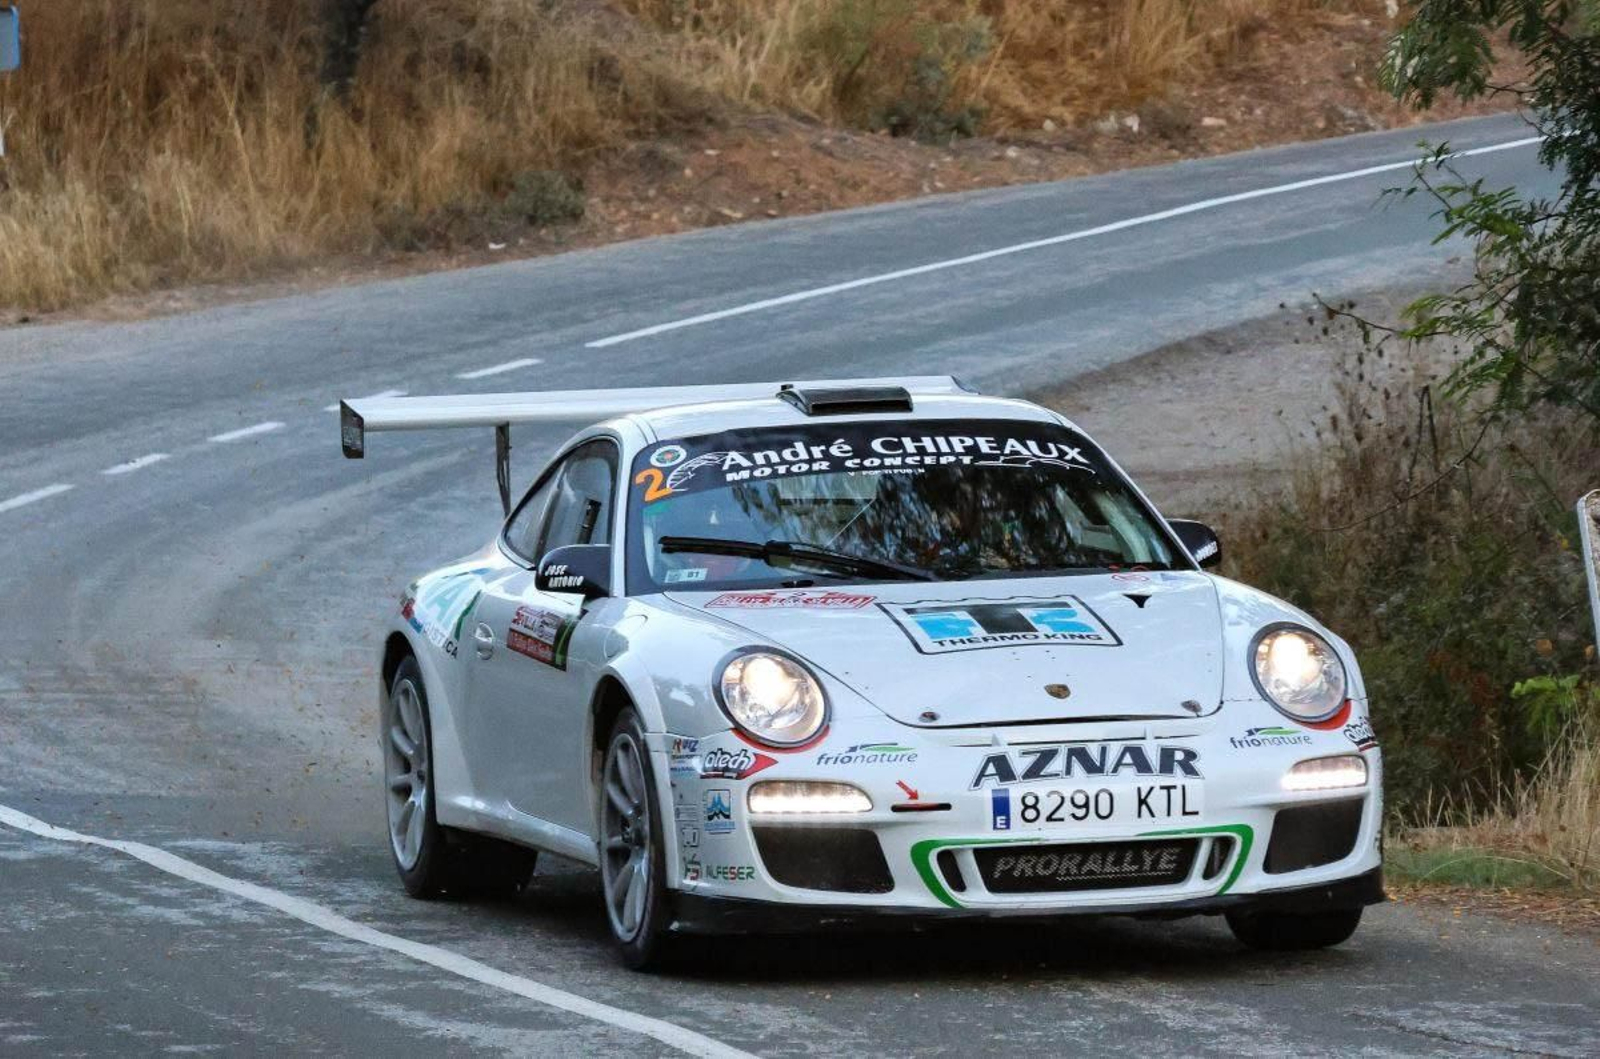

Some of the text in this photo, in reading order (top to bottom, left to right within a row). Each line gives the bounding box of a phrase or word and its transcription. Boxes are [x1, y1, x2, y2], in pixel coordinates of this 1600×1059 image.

[722, 436, 1090, 470] André CHIPEAUX
[725, 460, 831, 482] MOTOR
[844, 455, 974, 469] CONCEPT
[635, 468, 672, 502] 2
[544, 564, 568, 576] JOSE
[932, 633, 1104, 647] THERMO KING
[1229, 735, 1313, 749] frionature
[816, 752, 918, 766] frionature
[970, 744, 1203, 790] AZNAR
[1020, 784, 1200, 824] 8290 KTL
[996, 816, 1007, 829] E
[992, 847, 1180, 879] PRORALLYE
